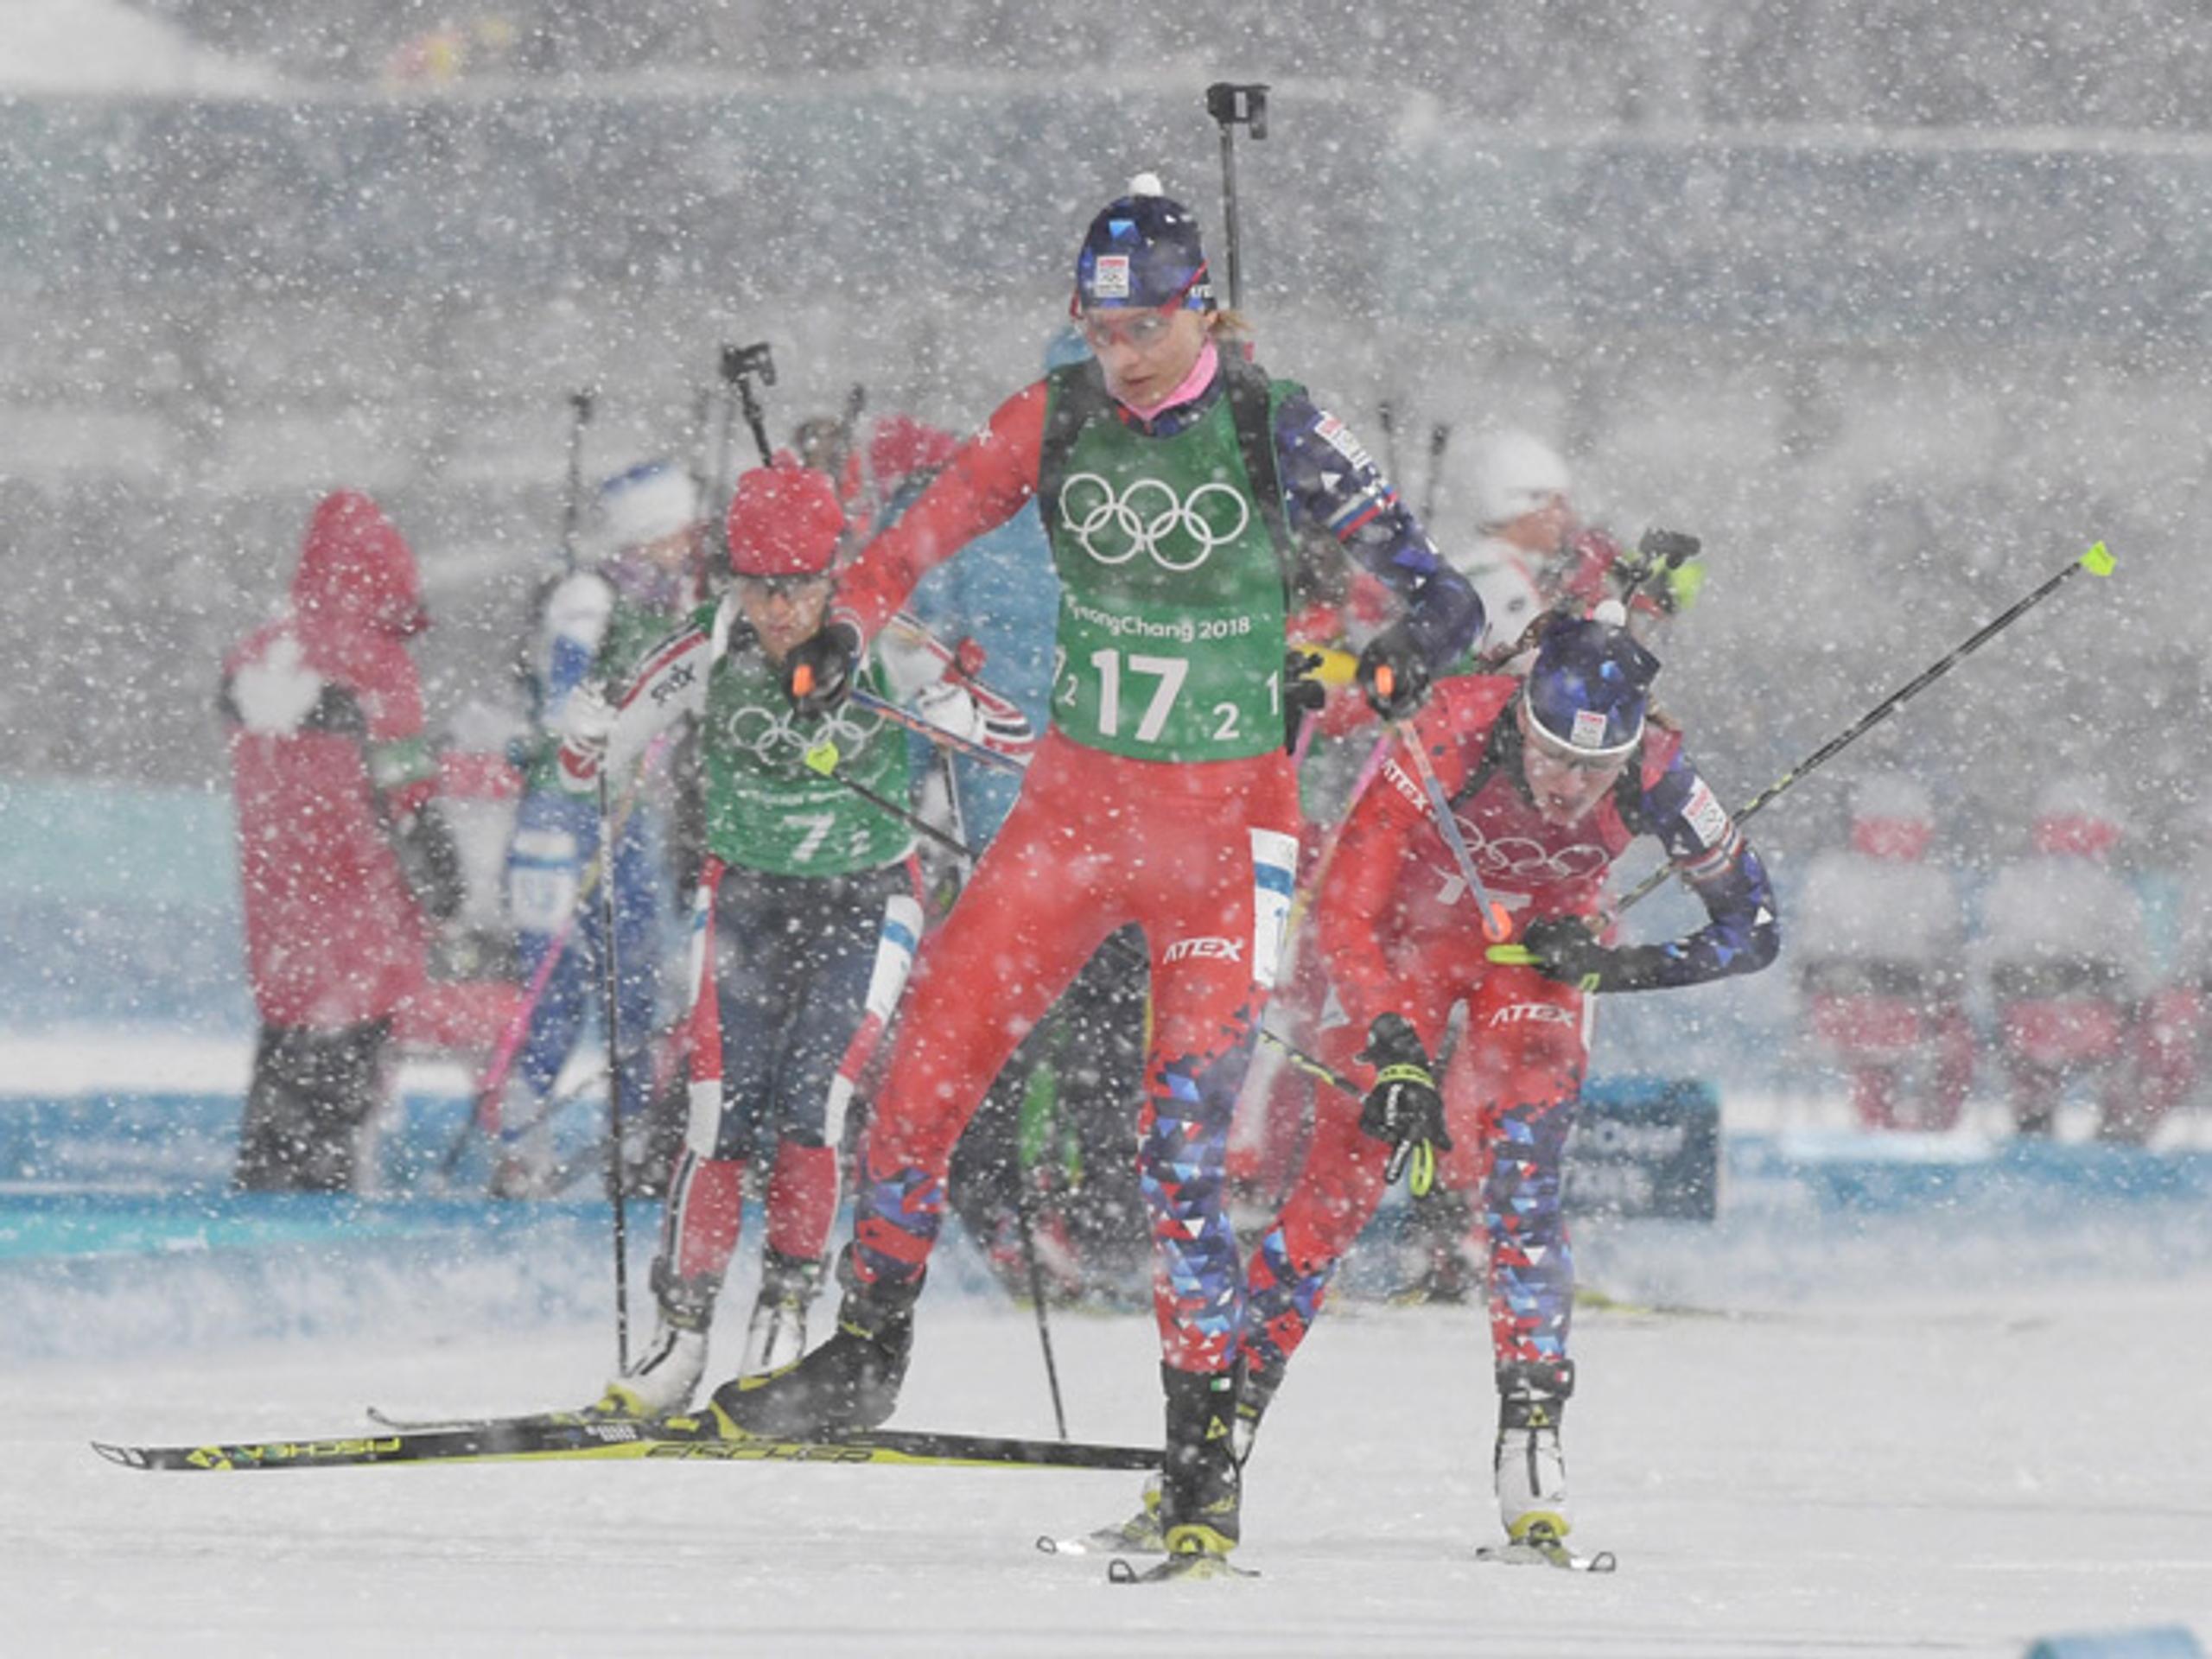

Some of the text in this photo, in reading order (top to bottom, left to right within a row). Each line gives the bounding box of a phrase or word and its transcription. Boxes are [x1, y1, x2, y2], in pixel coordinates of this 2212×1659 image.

[1198, 615, 1251, 640] 2018
[1090, 648, 1189, 743] 17
[1212, 702, 1240, 741] 2
[783, 810, 836, 862] 7
